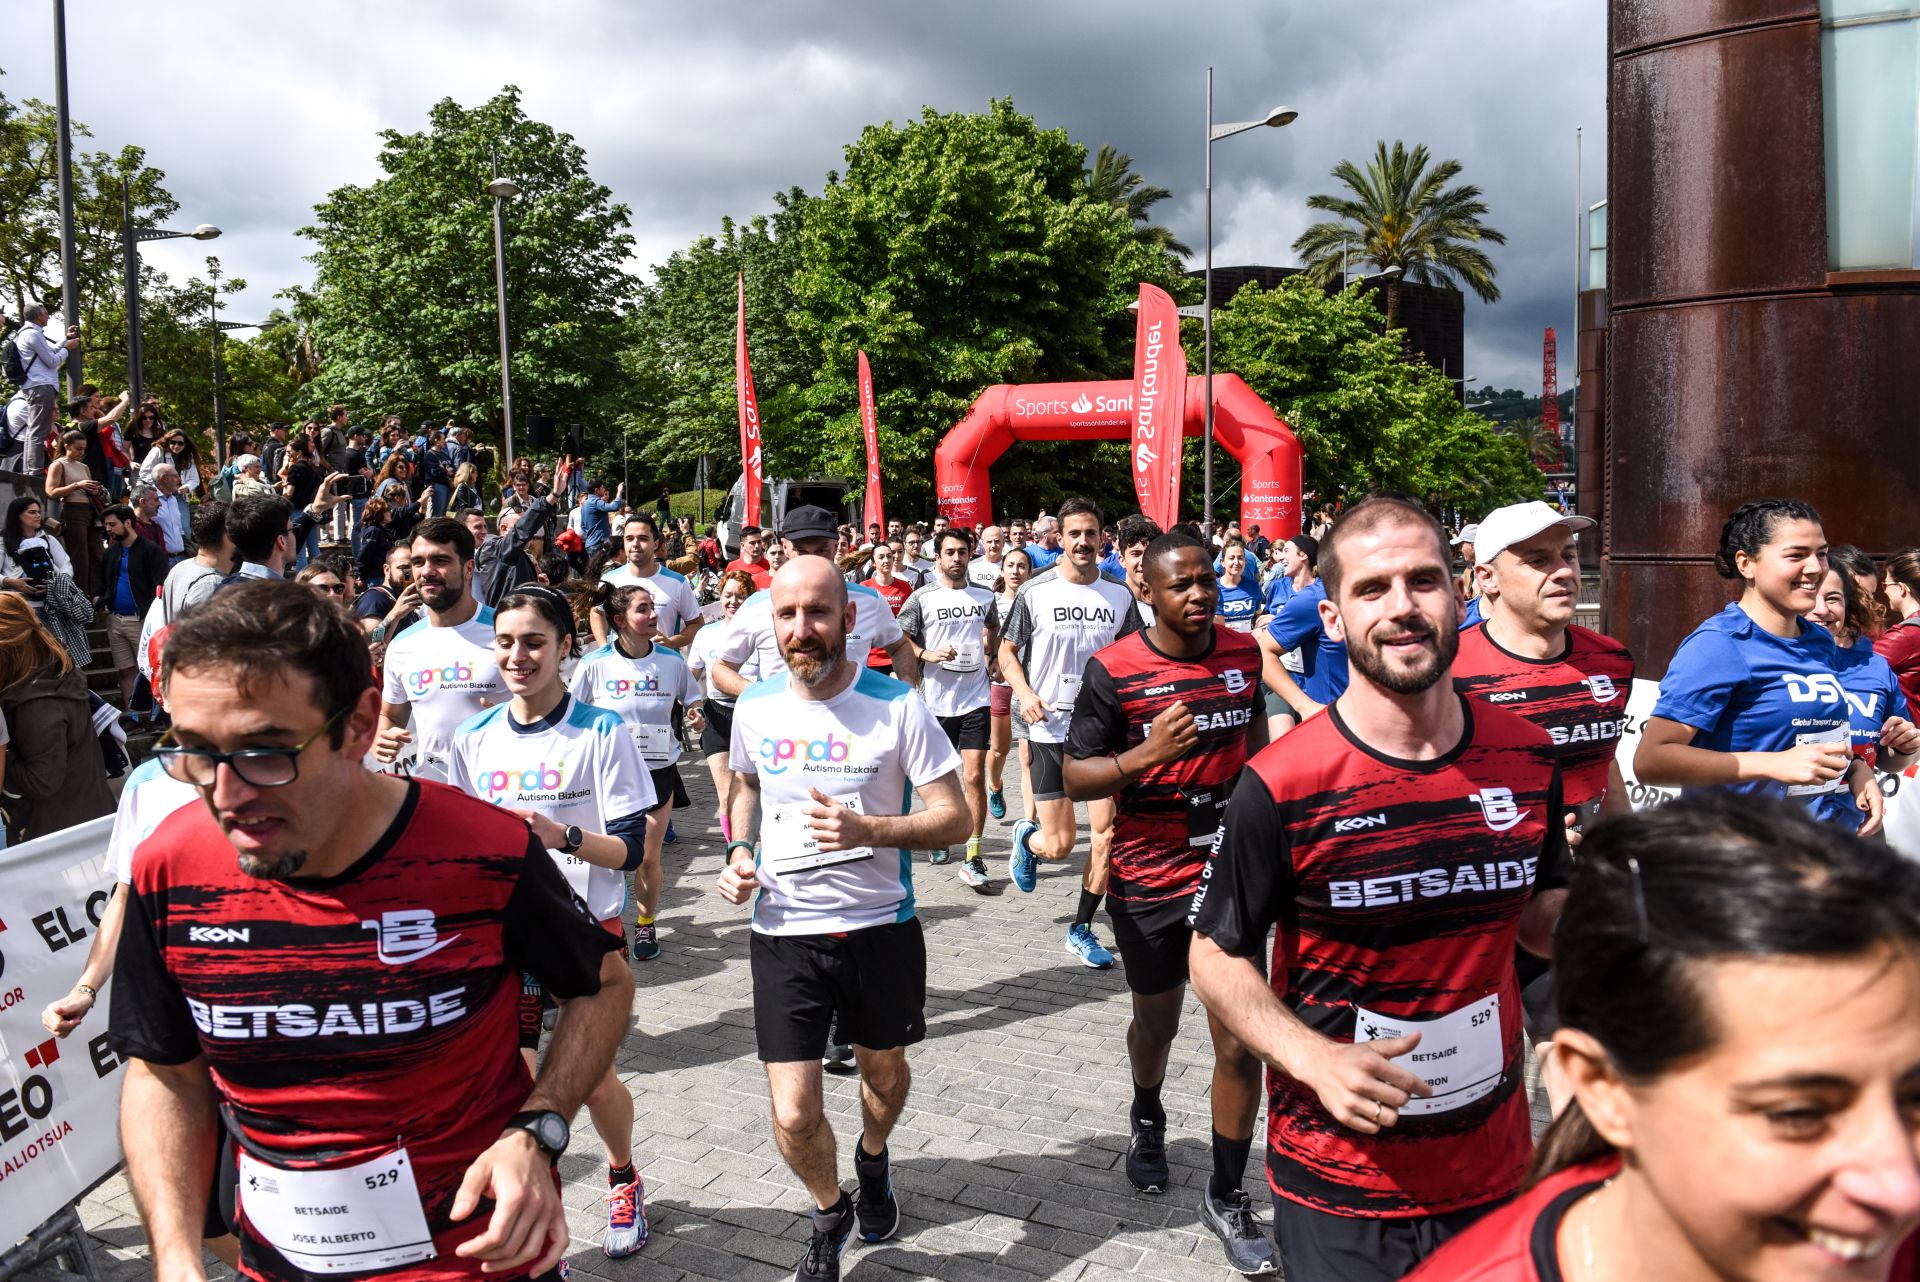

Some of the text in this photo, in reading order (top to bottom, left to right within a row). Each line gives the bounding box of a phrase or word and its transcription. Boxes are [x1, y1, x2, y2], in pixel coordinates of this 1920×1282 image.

[1016, 398, 1068, 419] Sports
[1069, 420, 1127, 428] sportssantander.es
[941, 484, 964, 494] Sports
[1252, 480, 1280, 490] Sports
[1250, 494, 1293, 503] Santander
[937, 605, 987, 620] BIOLAN
[1223, 600, 1252, 612] DSV
[1053, 606, 1115, 623] BIOLAN
[408, 661, 474, 690] apnabi
[605, 675, 659, 695] apnabi
[1791, 718, 1811, 727] Global
[759, 732, 853, 767] apnabi
[802, 763, 879, 774] Autismo Bizkaia
[477, 761, 565, 799] apnabi
[516, 789, 591, 801] Autismo Bizkaia
[841, 800, 856, 809] 15
[1202, 862, 1214, 879] OF
[1328, 856, 1539, 908] BETSAIDE
[1190, 884, 1209, 913] WILL
[1187, 914, 1197, 925] A
[32, 906, 87, 952] EL
[186, 987, 467, 1038] BETSAIDE
[1471, 1008, 1491, 1027] 529
[1412, 1046, 1458, 1062] BETSAIDE
[0, 1074, 53, 1147] EO
[365, 1168, 399, 1190] 529
[294, 1205, 349, 1216] BETSAIDE
[292, 1230, 376, 1244] JOSE ALBERTO
